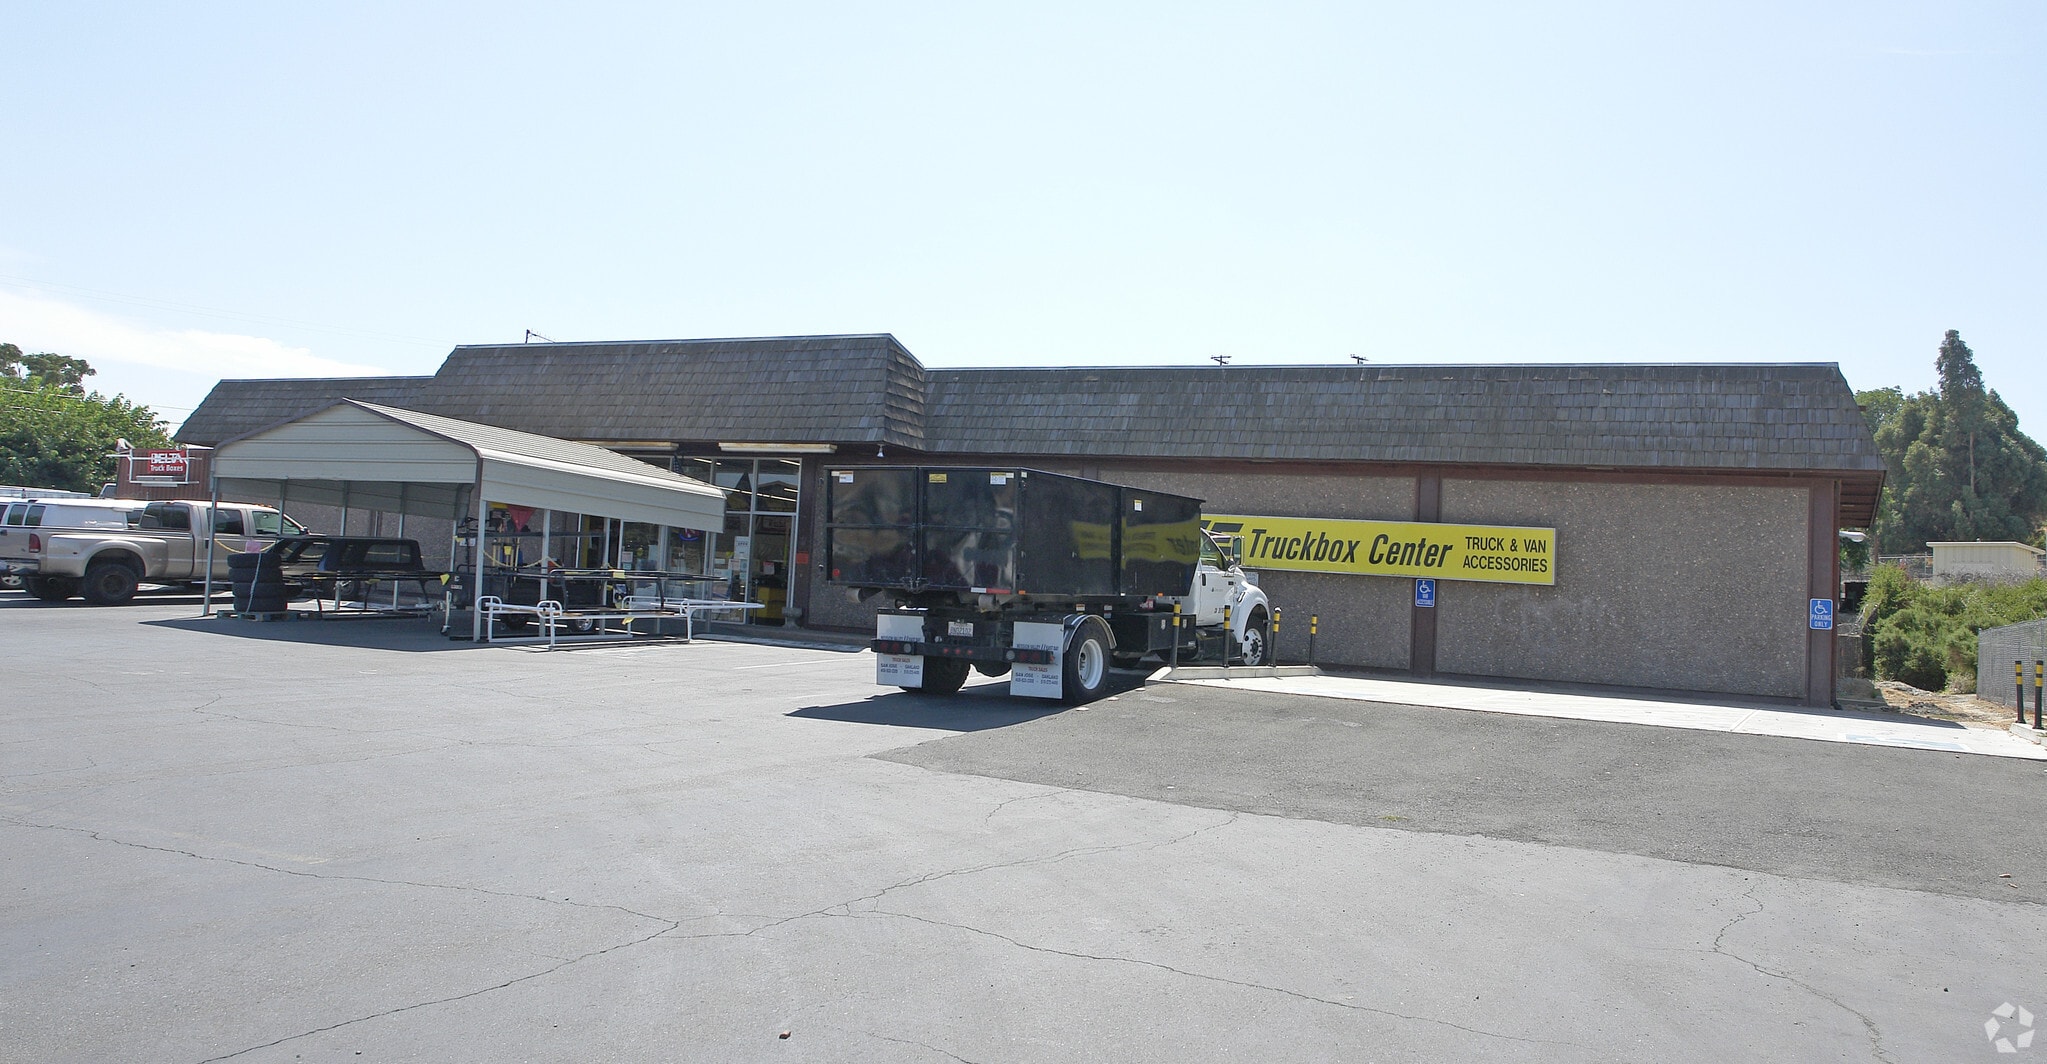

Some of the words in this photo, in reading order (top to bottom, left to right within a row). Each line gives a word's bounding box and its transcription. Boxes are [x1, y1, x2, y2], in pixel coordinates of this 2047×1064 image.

[151, 452, 184, 464] DELTA
[150, 464, 165, 472] Truck
[166, 464, 183, 472] Boxes
[1249, 528, 1360, 564] Truckbox
[1368, 533, 1453, 568] Center
[1465, 536, 1505, 552] TRUCK
[1510, 538, 1518, 552] &
[1523, 539, 1547, 553] VAN
[1462, 555, 1548, 573] ACCESSORIES
